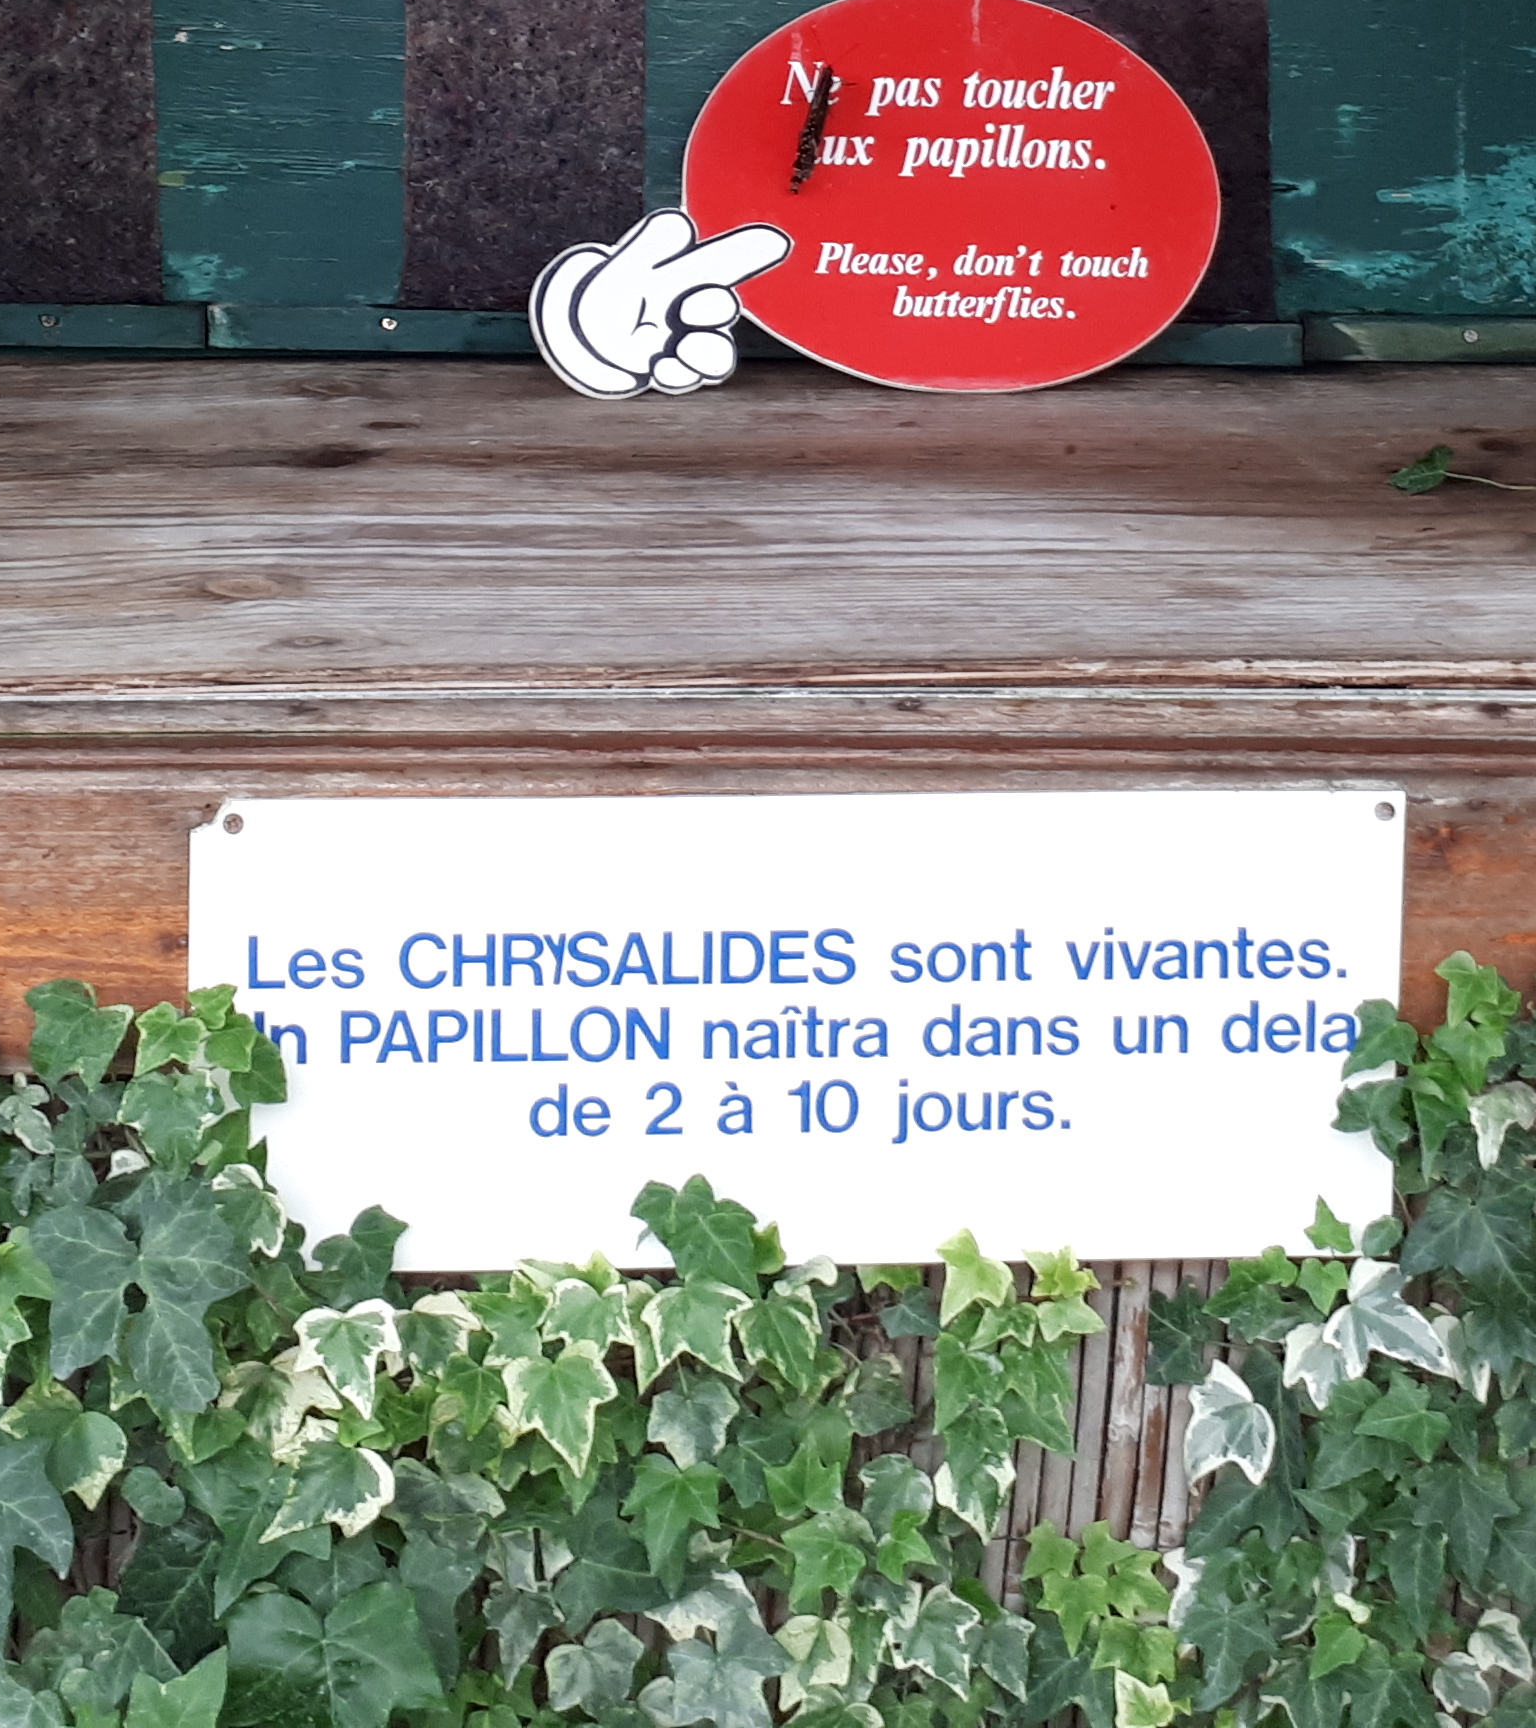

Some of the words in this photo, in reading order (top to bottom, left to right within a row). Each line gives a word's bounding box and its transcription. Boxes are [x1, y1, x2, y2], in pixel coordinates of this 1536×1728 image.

[864, 76, 942, 117] pas
[962, 65, 1117, 111] toucher
[811, 134, 876, 166] ux
[897, 122, 1108, 178] papillons.
[814, 241, 939, 281] Please,
[1059, 245, 1150, 279] touch
[891, 284, 1077, 322] butterflies.
[247, 935, 366, 991] Les
[398, 927, 858, 990] CHRYSALIDES
[890, 929, 1034, 985] sont
[1067, 927, 1348, 982] vivantes.
[253, 1010, 308, 1065] n
[339, 1005, 672, 1065] PAPILLON
[702, 1005, 890, 1060] naîtra
[922, 1004, 1082, 1059] dans
[1113, 1014, 1190, 1056] un
[1221, 1000, 1358, 1055] dela
[528, 1083, 613, 1139] de
[645, 1081, 684, 1137] 2
[717, 1081, 755, 1136] à
[788, 1079, 861, 1135] 10
[891, 1079, 1072, 1145] jours.
